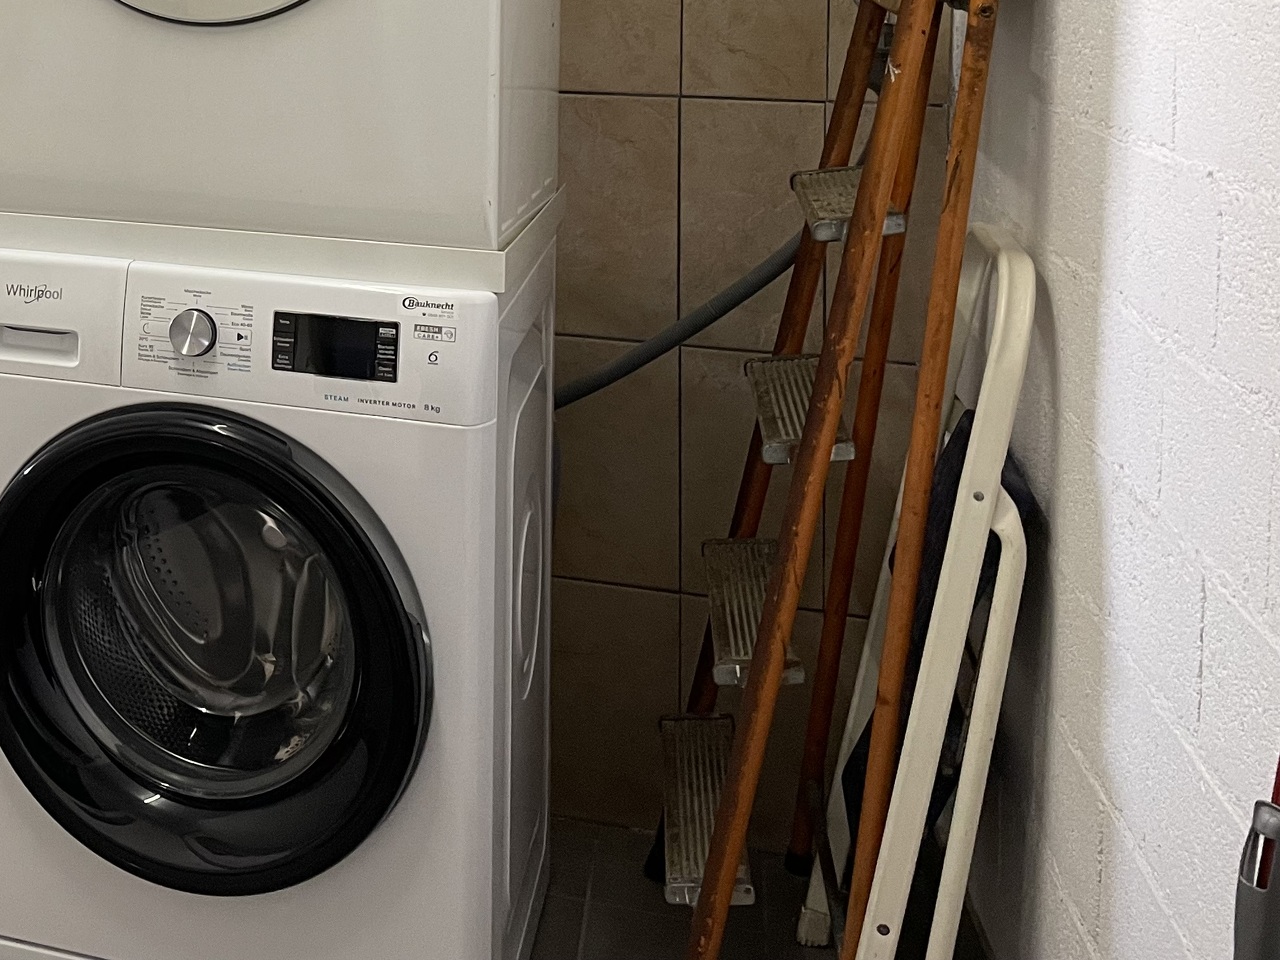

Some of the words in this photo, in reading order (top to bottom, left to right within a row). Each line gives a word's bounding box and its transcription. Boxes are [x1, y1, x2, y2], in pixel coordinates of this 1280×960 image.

[6, 283, 63, 303] Whirlpool
[402, 296, 454, 310] Bauknecht
[428, 350, 439, 363] 6
[324, 394, 349, 402] STEAM
[357, 398, 390, 407] INVERTER
[391, 401, 416, 410] MOTOR
